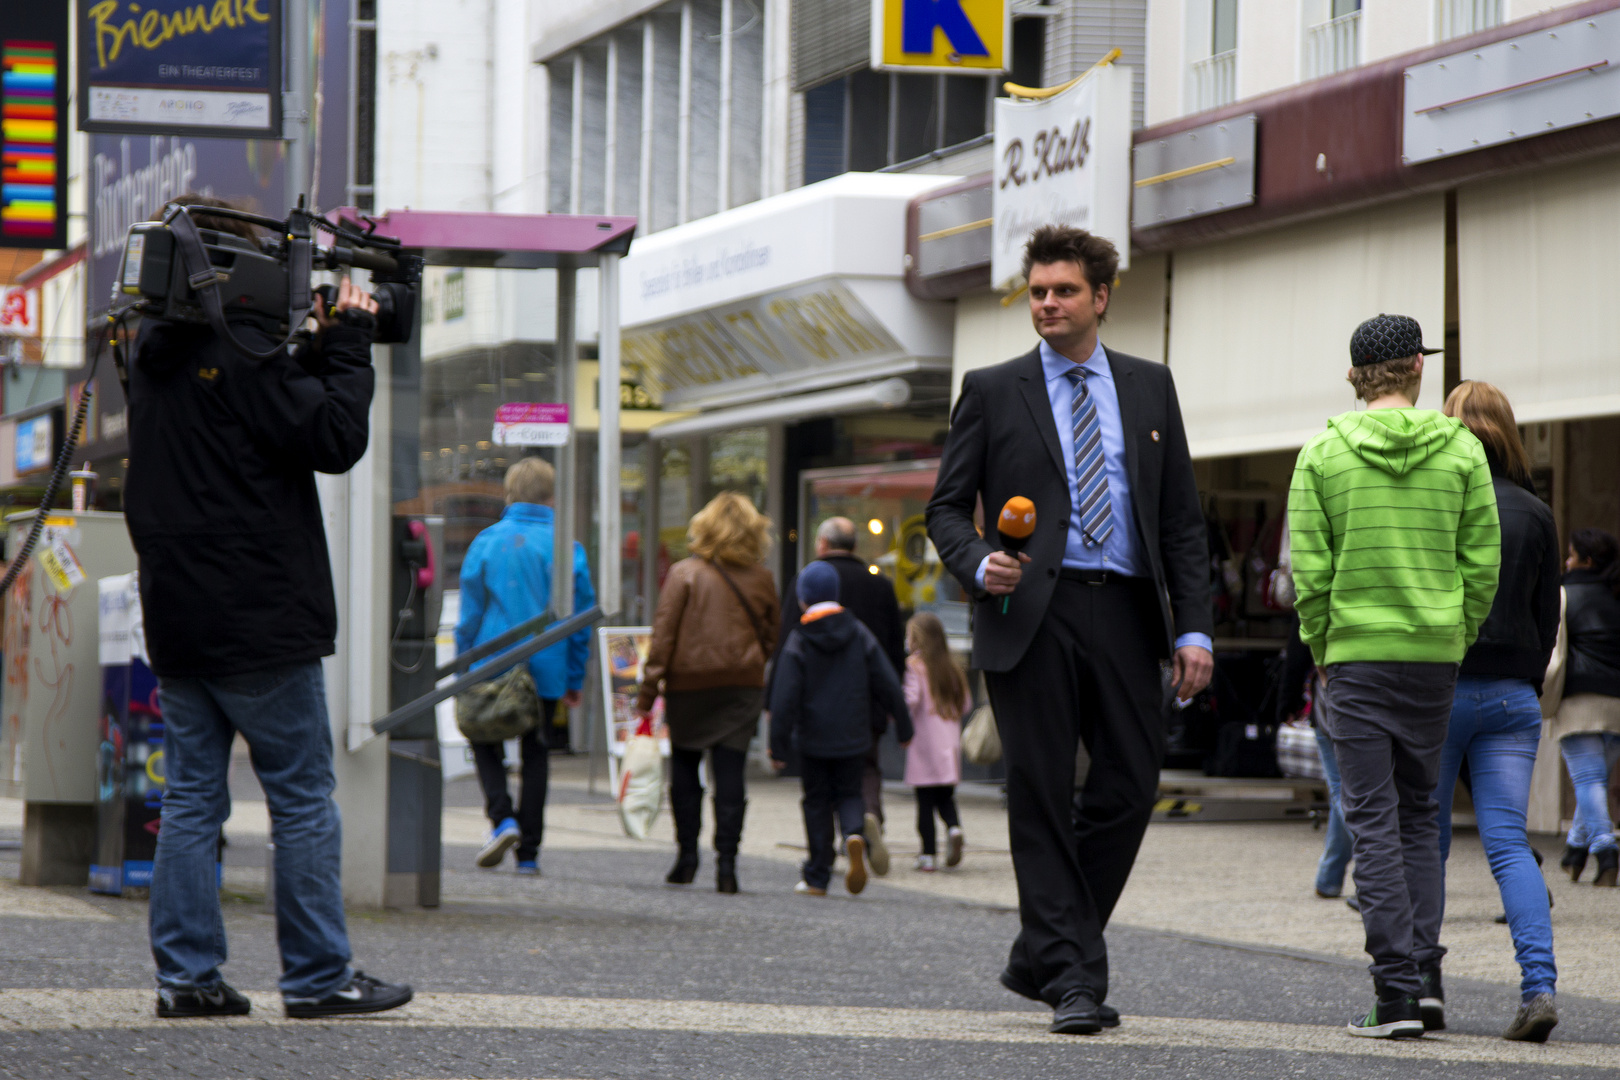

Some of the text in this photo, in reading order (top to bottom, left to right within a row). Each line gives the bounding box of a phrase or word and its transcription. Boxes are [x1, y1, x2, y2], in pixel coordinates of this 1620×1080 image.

[158, 64, 261, 80] EIN THEATERFEST
[1000, 117, 1092, 190] R. Kalb
